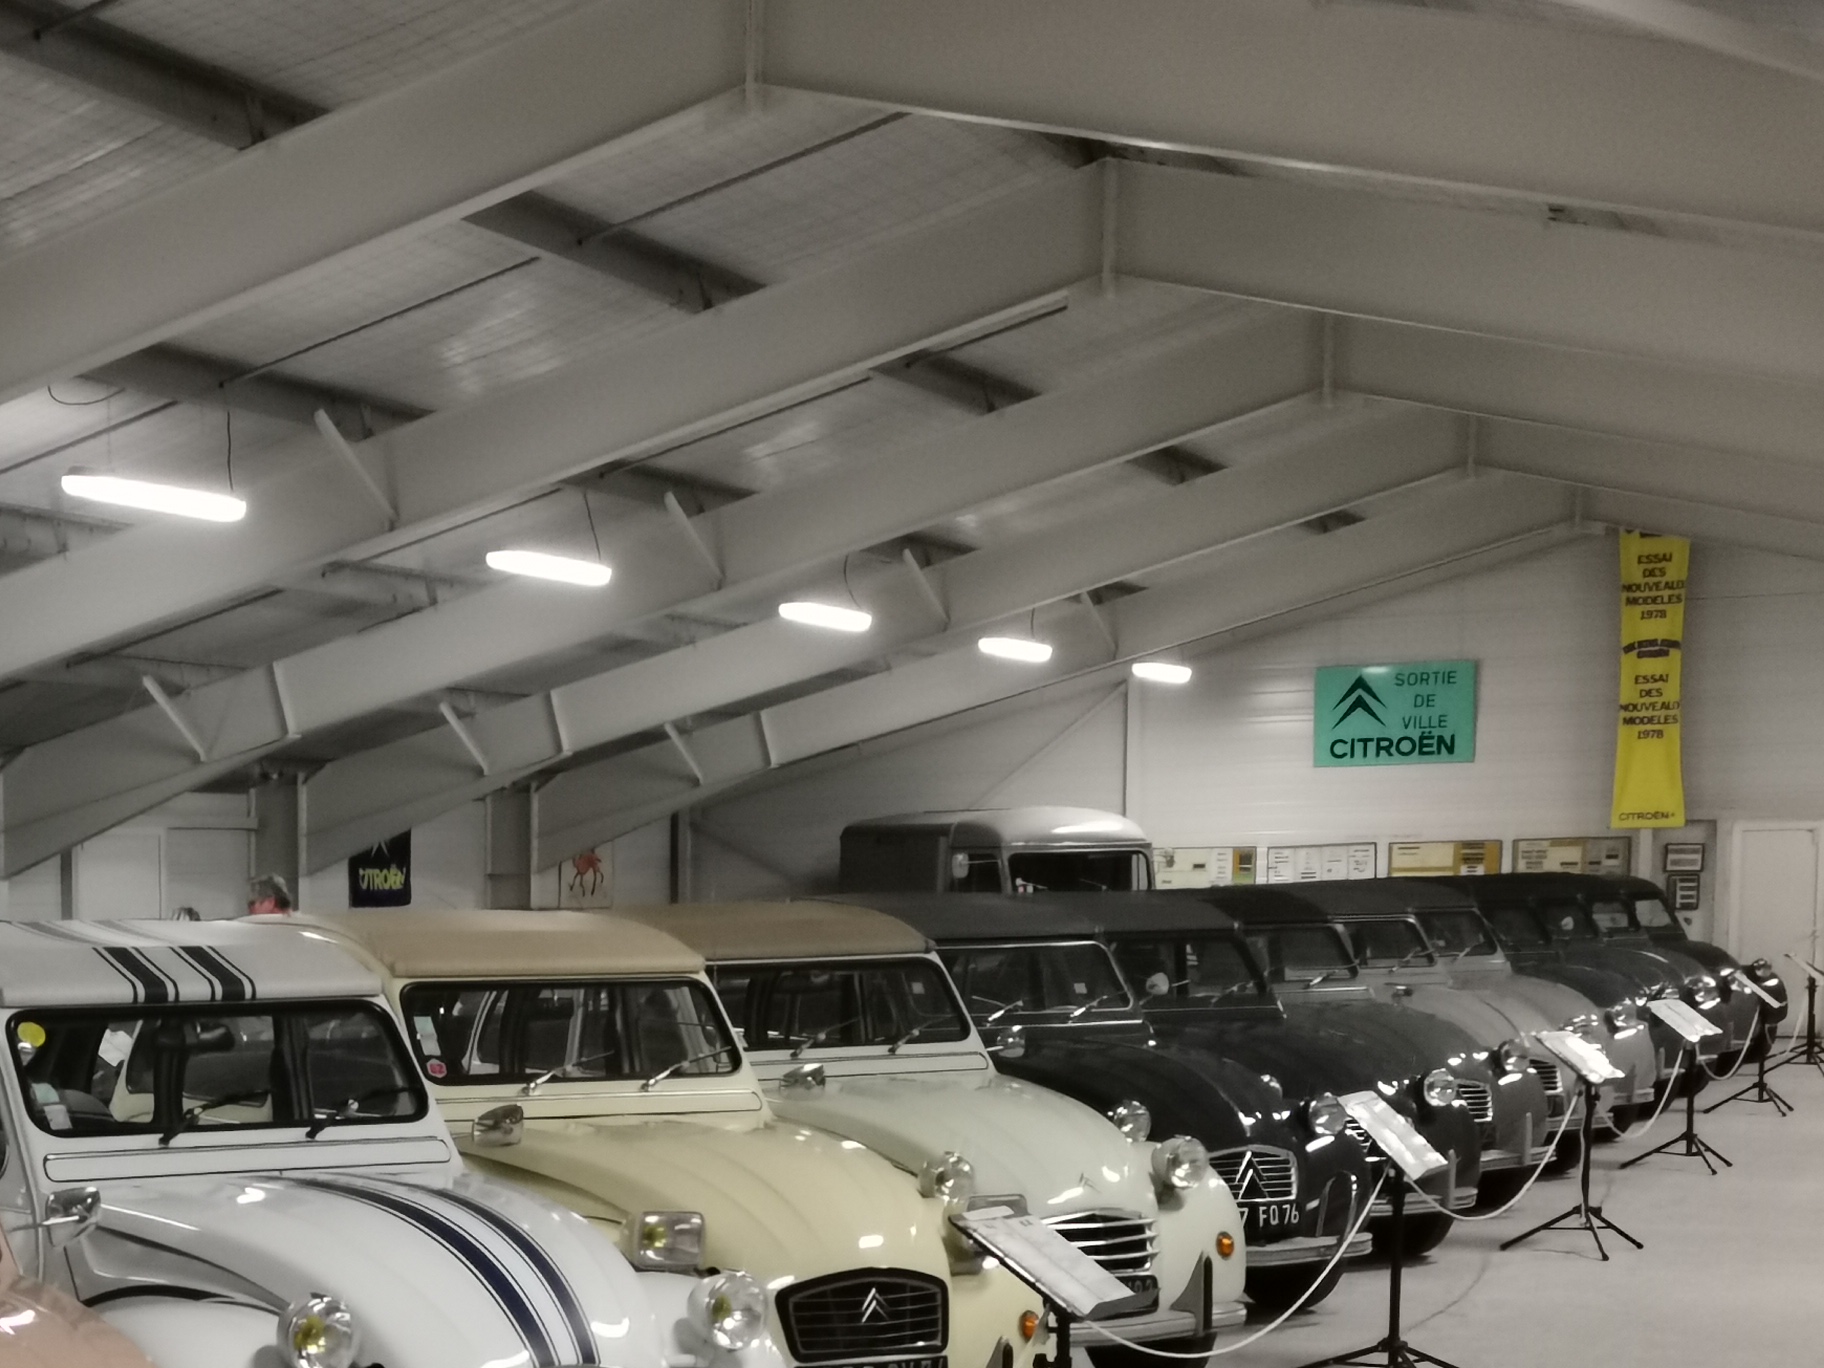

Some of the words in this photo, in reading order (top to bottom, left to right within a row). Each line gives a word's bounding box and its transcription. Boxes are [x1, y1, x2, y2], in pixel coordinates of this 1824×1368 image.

[1637, 552, 1672, 565] ESSAI
[1642, 567, 1666, 578] DES
[1394, 670, 1457, 687] SORTIE
[1634, 673, 1669, 685] ESSAI
[1639, 688, 1663, 698] DES
[1413, 694, 1436, 708] DE
[1402, 714, 1448, 730] VILLE
[1622, 714, 1679, 725] MODELES
[1330, 731, 1455, 759] CITROËN
[1282, 1203, 1299, 1225] 76
